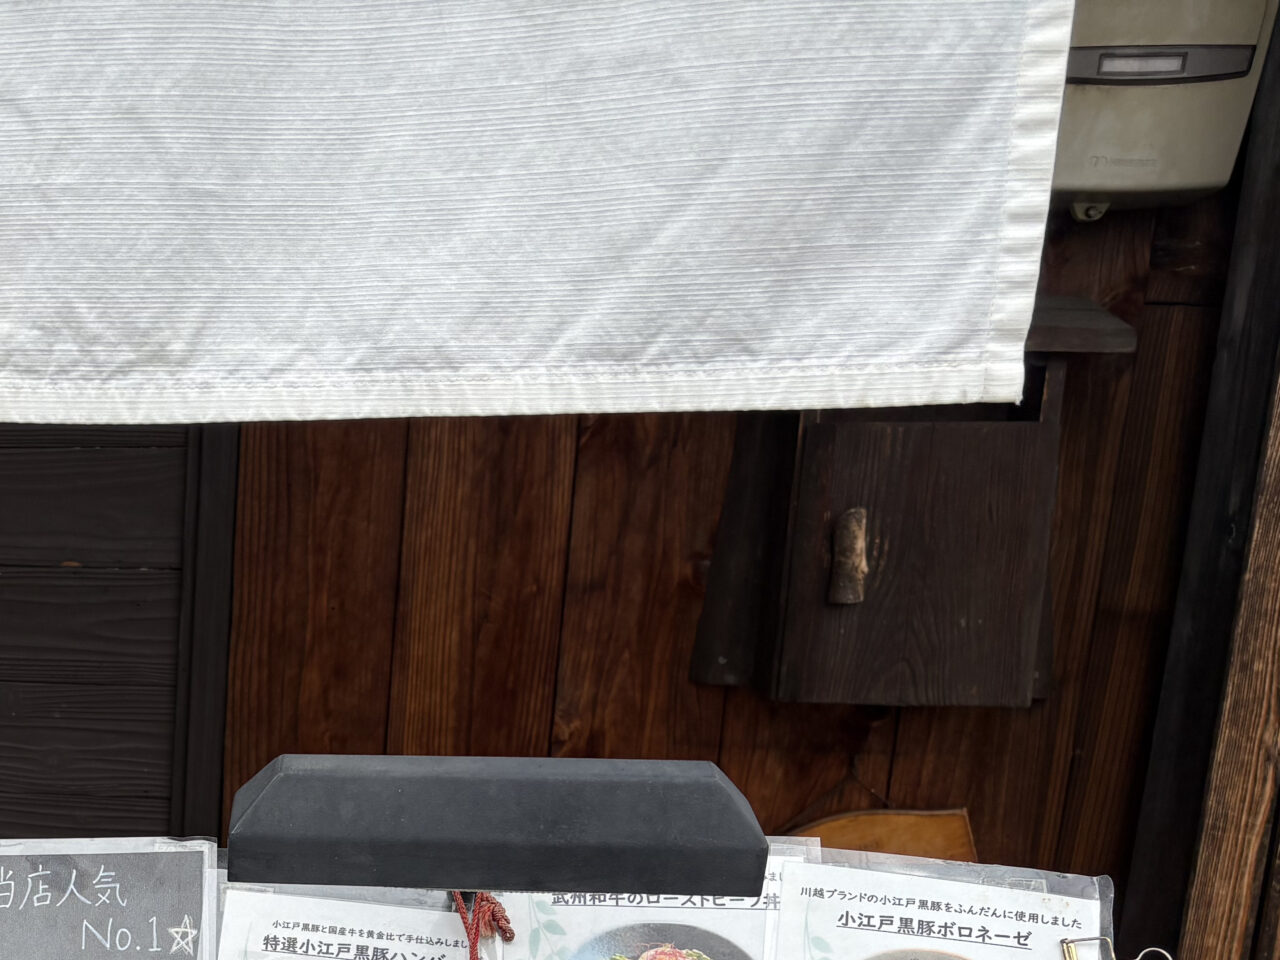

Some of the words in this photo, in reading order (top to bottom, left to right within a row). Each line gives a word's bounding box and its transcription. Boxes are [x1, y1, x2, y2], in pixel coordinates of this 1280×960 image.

[800, 886, 1083, 930] 川越ブランドの小江戸黒豚をふんだんに使用しました
[81, 916, 162, 951] No.1
[272, 919, 468, 950] 小江戸黒豚と国産牛を黄金比で手仕込みしまし
[837, 909, 1033, 948] 小江戸黒豚ボロネーゼ
